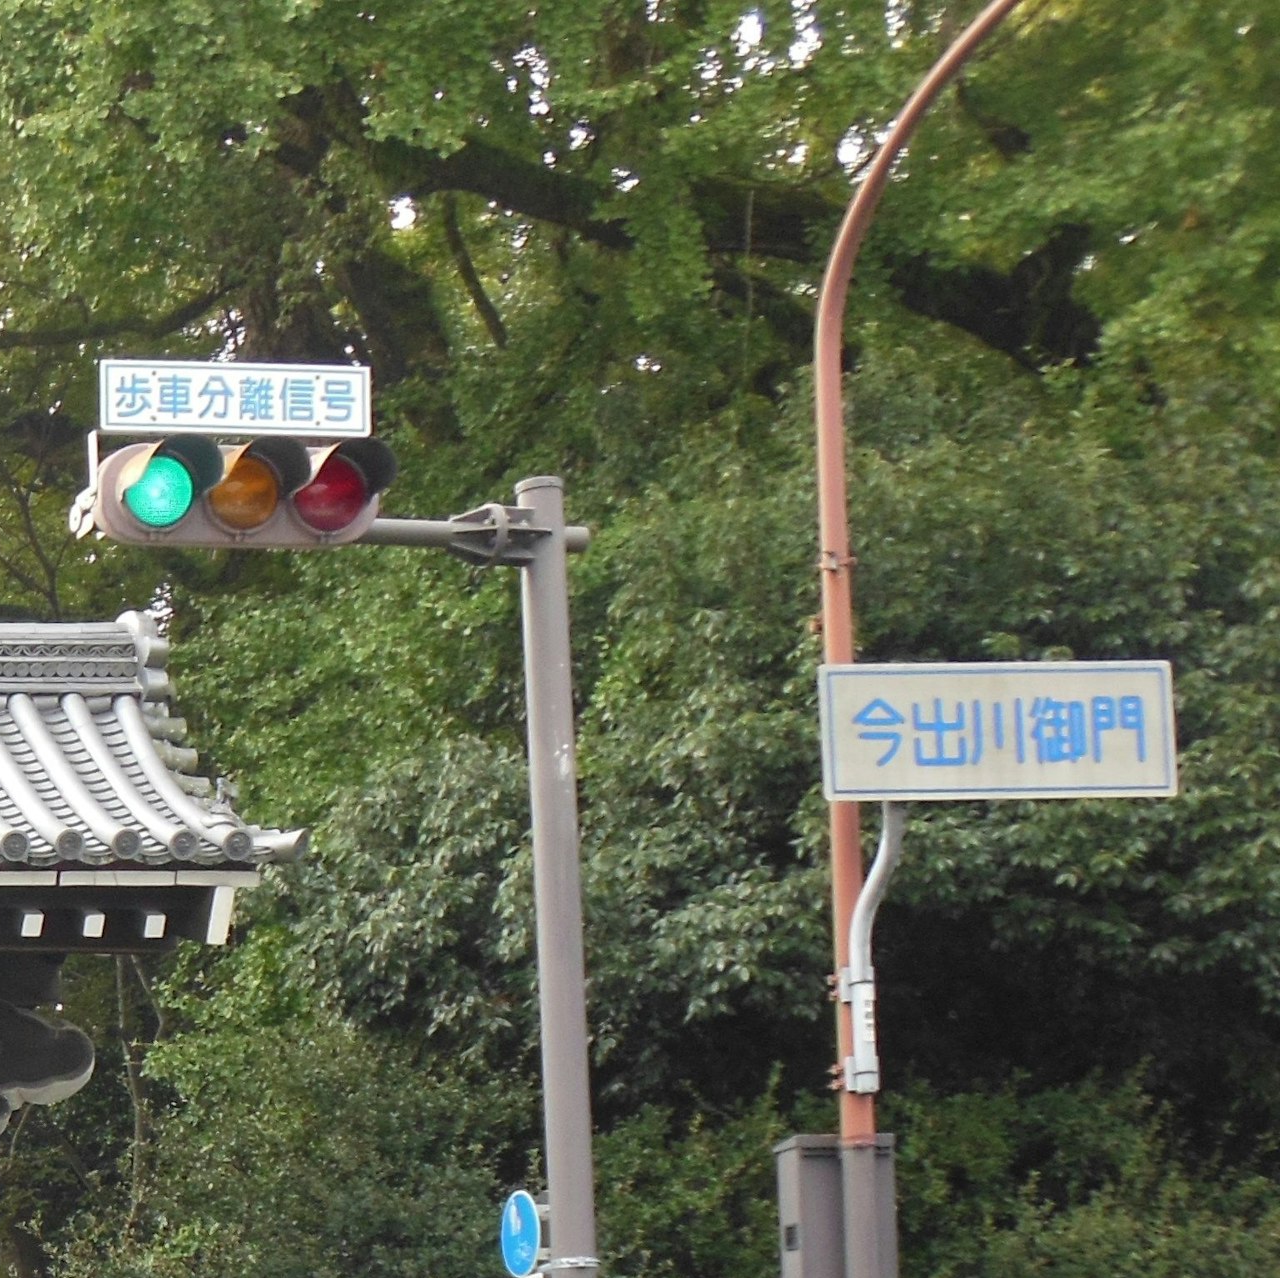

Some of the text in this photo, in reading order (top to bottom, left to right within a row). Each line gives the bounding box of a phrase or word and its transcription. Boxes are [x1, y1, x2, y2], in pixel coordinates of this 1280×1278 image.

[115, 374, 356, 422] 歩車分離信号
[853, 696, 1146, 766] 今出川御門
